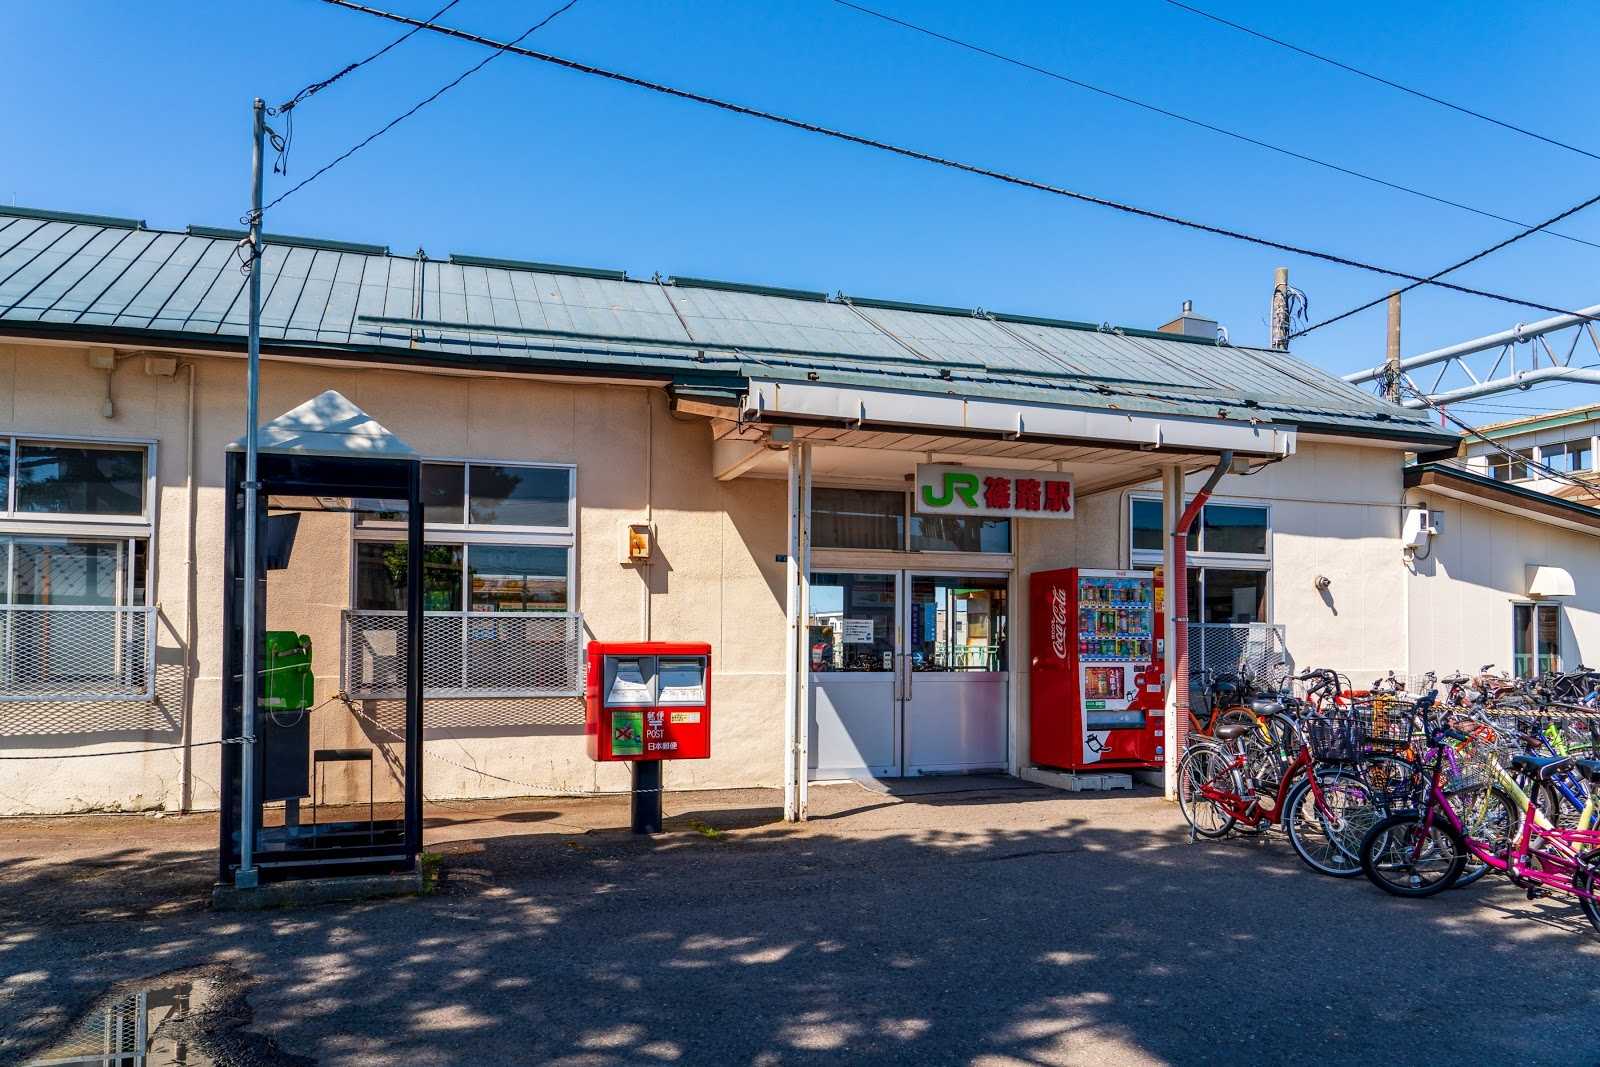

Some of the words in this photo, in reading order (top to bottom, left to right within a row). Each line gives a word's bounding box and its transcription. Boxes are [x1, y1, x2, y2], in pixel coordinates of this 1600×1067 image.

[922, 472, 979, 508] JR
[1053, 585, 1066, 659] Coca-Cola
[646, 730, 664, 739] POST
